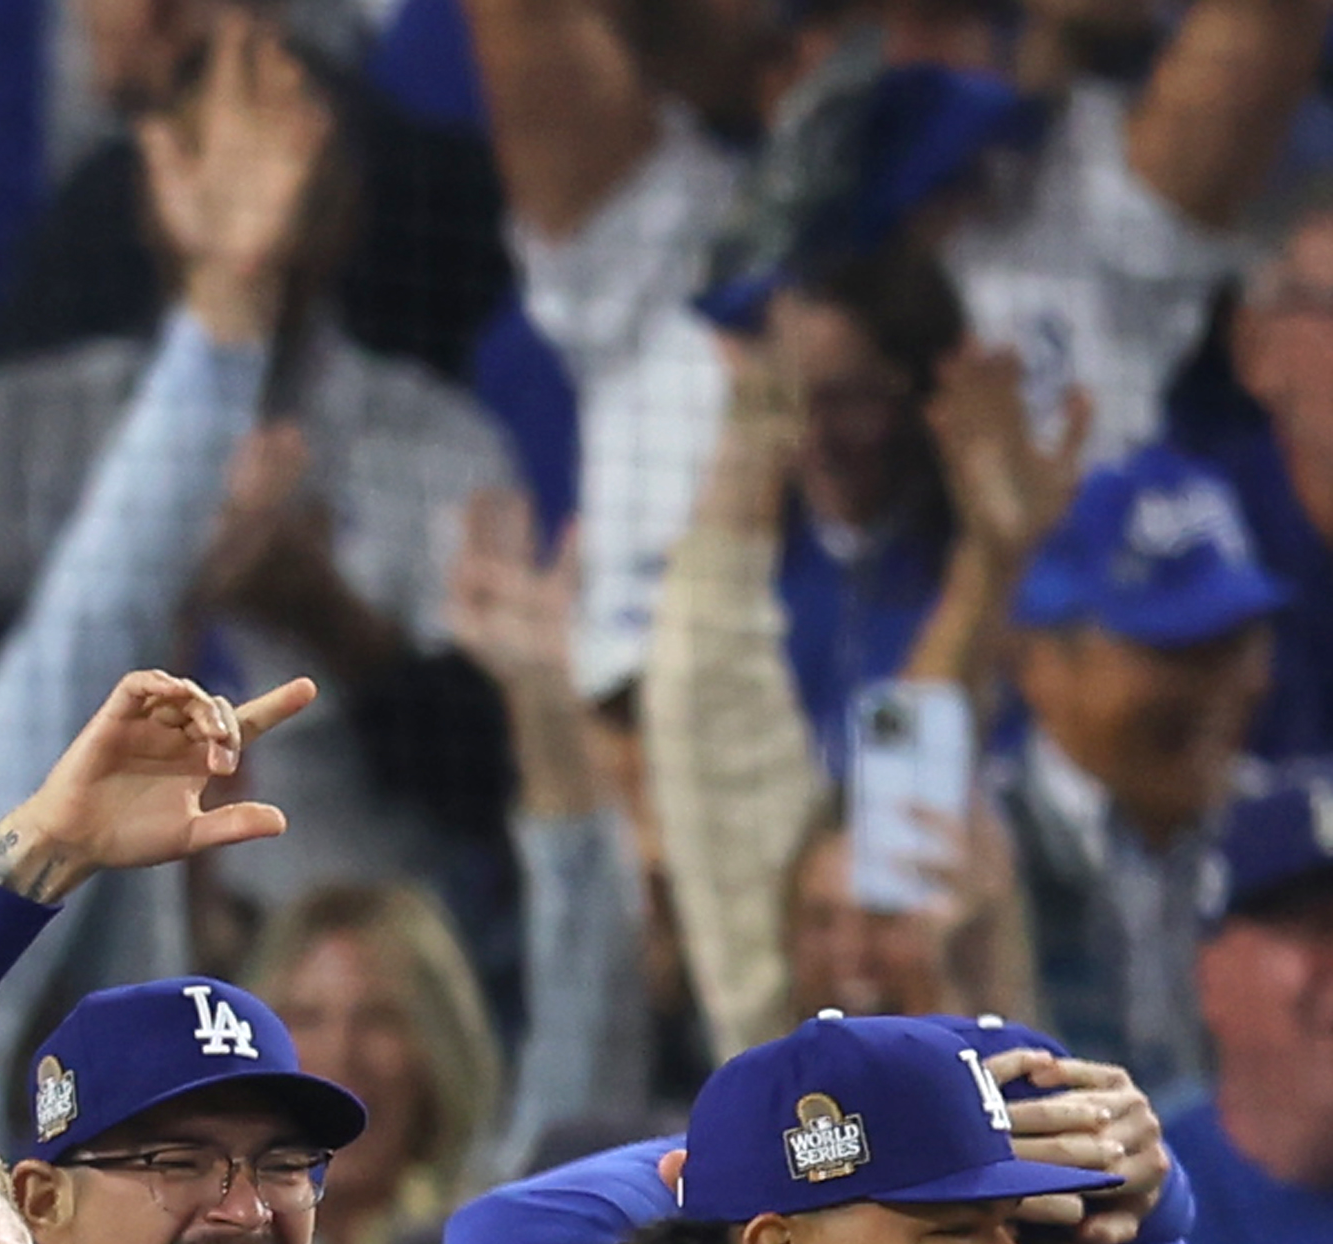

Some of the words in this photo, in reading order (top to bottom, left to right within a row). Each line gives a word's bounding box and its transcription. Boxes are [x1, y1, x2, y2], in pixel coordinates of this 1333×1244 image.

[183, 985, 258, 1059] LA
[958, 1048, 1012, 1131] LA
[789, 1123, 860, 1152] WORLD
[795, 1139, 862, 1169] SERIES
